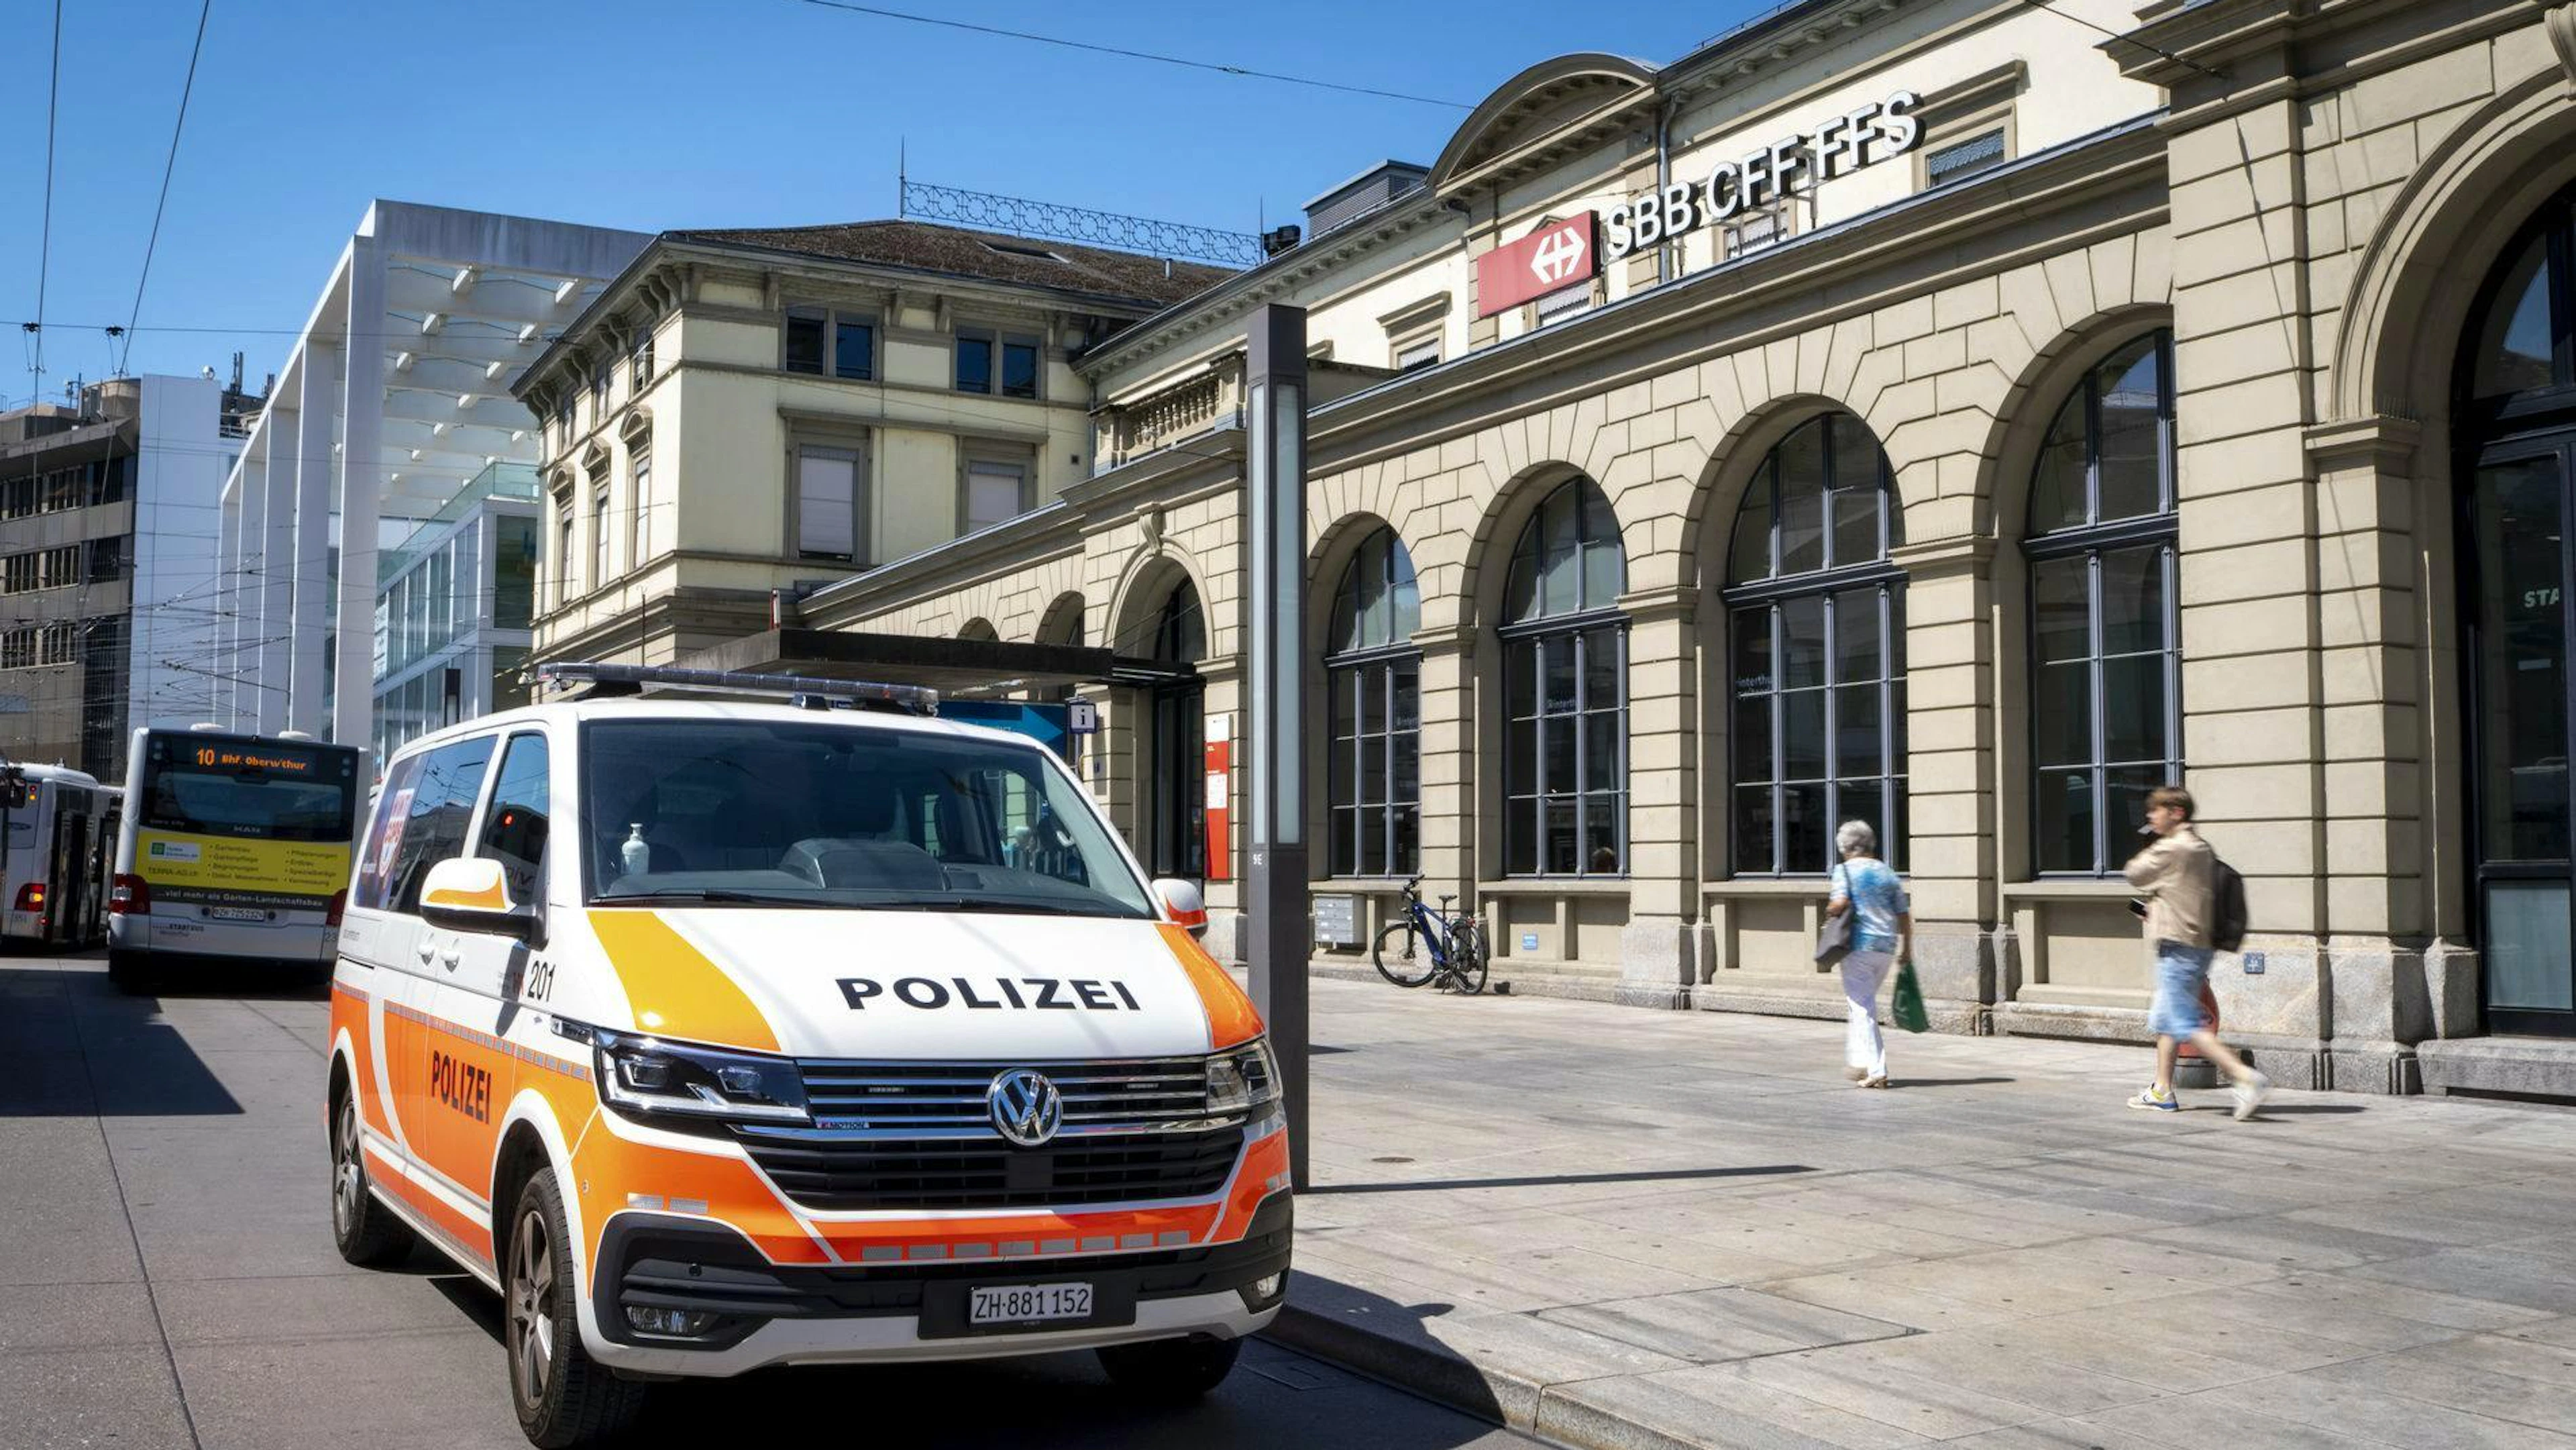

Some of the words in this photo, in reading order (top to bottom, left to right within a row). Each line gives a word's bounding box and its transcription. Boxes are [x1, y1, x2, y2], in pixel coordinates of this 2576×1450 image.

[1607, 180, 1695, 258] SBB
[1706, 135, 1800, 219] CFF
[1815, 89, 1919, 180] FFS
[197, 747, 215, 766] 10
[528, 960, 556, 1002] 201
[836, 978, 1140, 1011] POLIZEI
[431, 1049, 492, 1125] POLIZEI
